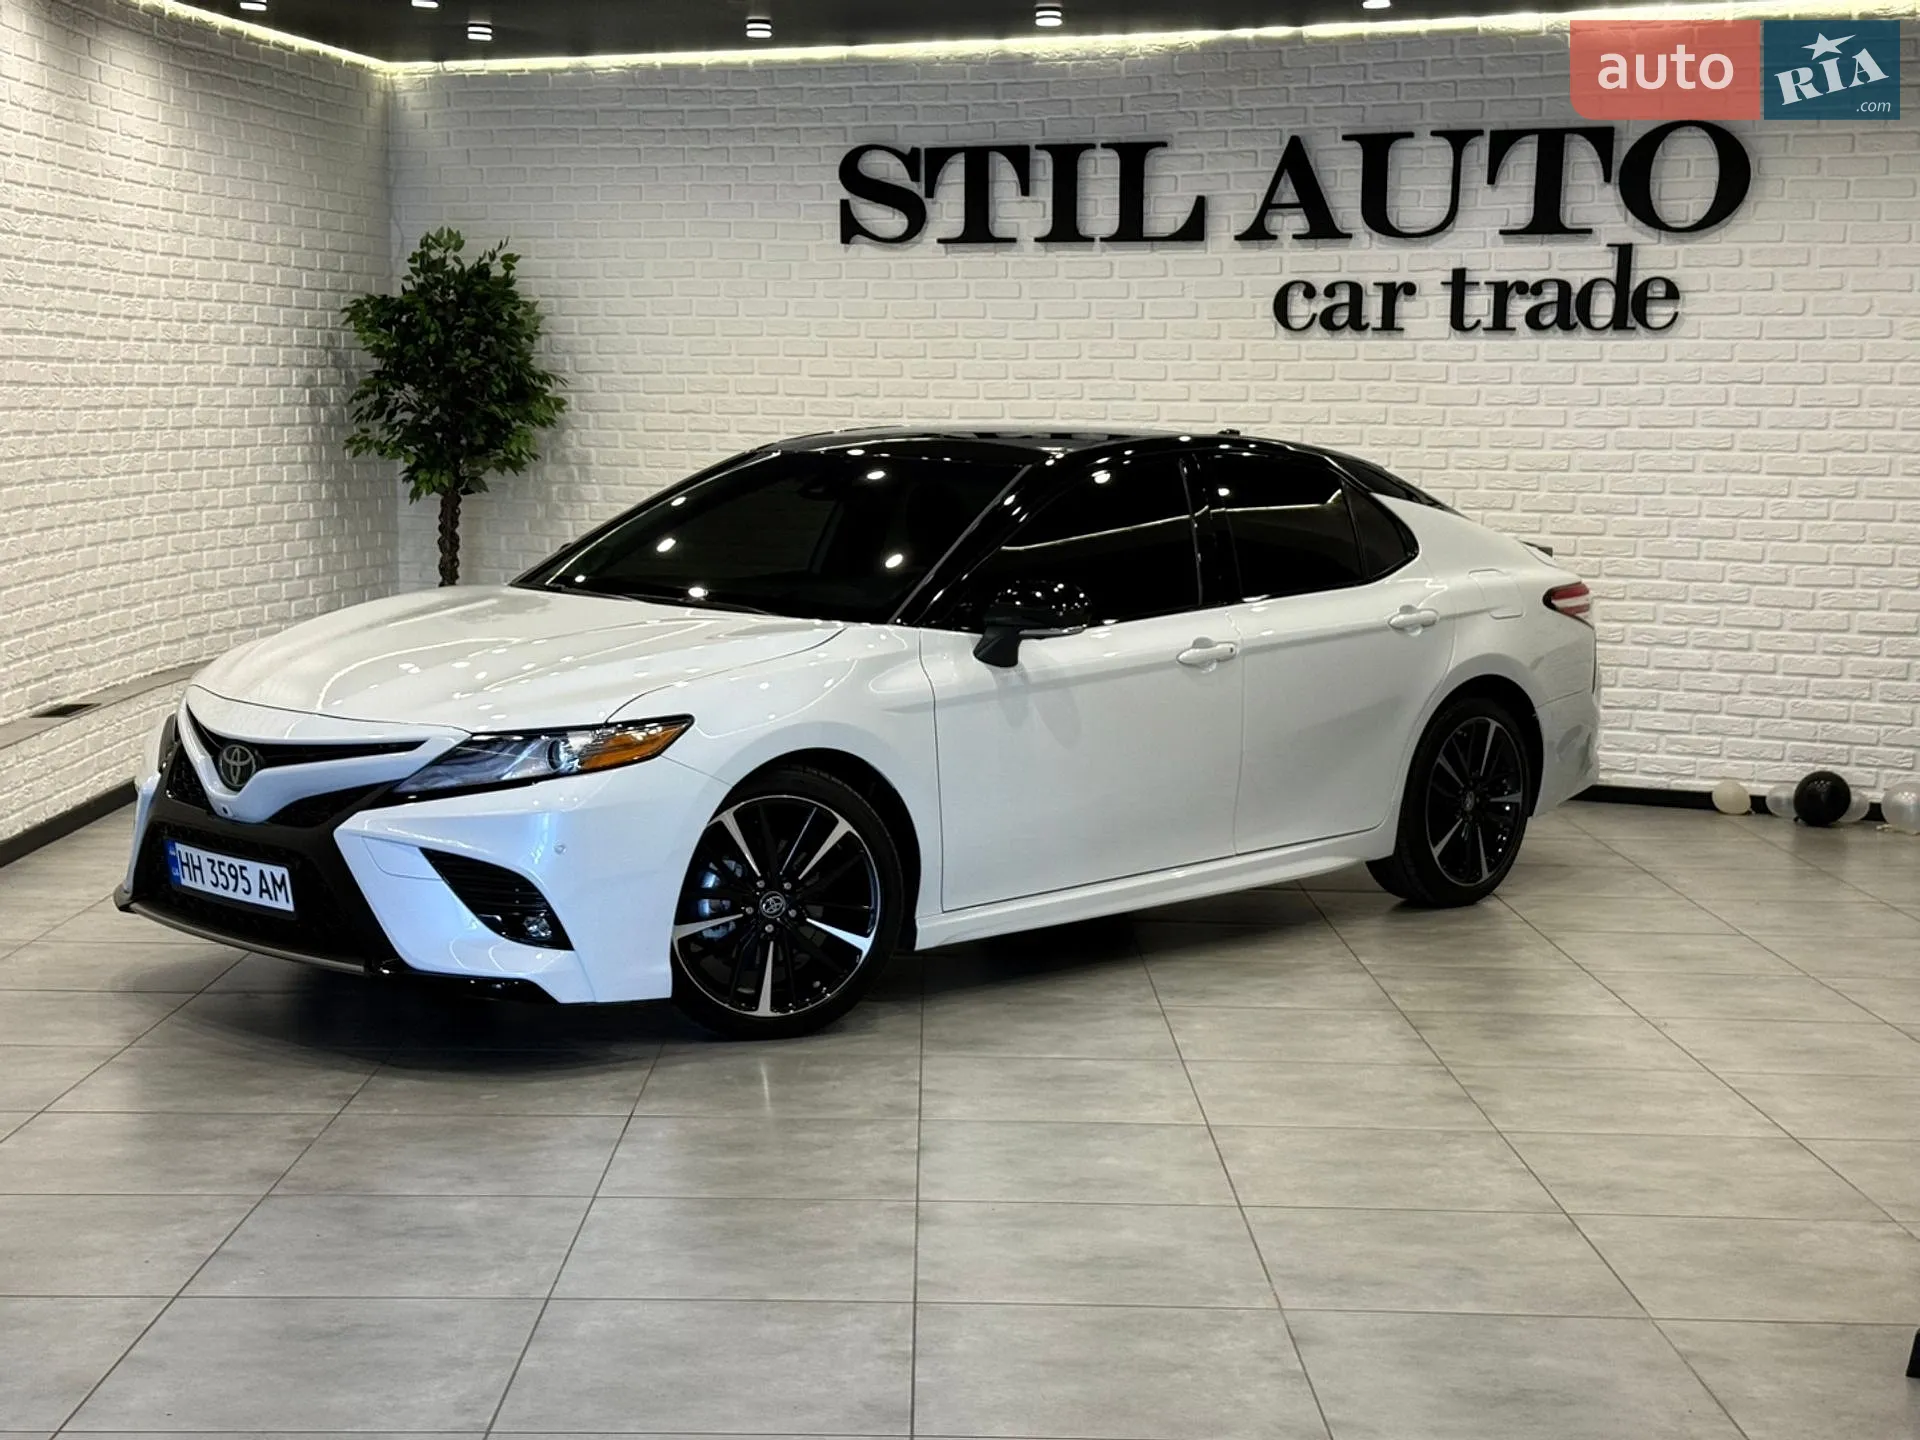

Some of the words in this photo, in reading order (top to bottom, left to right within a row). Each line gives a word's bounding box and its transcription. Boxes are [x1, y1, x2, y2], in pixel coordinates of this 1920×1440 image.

[838, 141, 1207, 245] STIL
[1233, 119, 1752, 242] AUTO
[1273, 274, 1417, 333] car
[1441, 243, 1681, 333] trade
[178, 850, 205, 885] HH
[207, 858, 252, 895] 3595
[259, 869, 290, 903] AM
